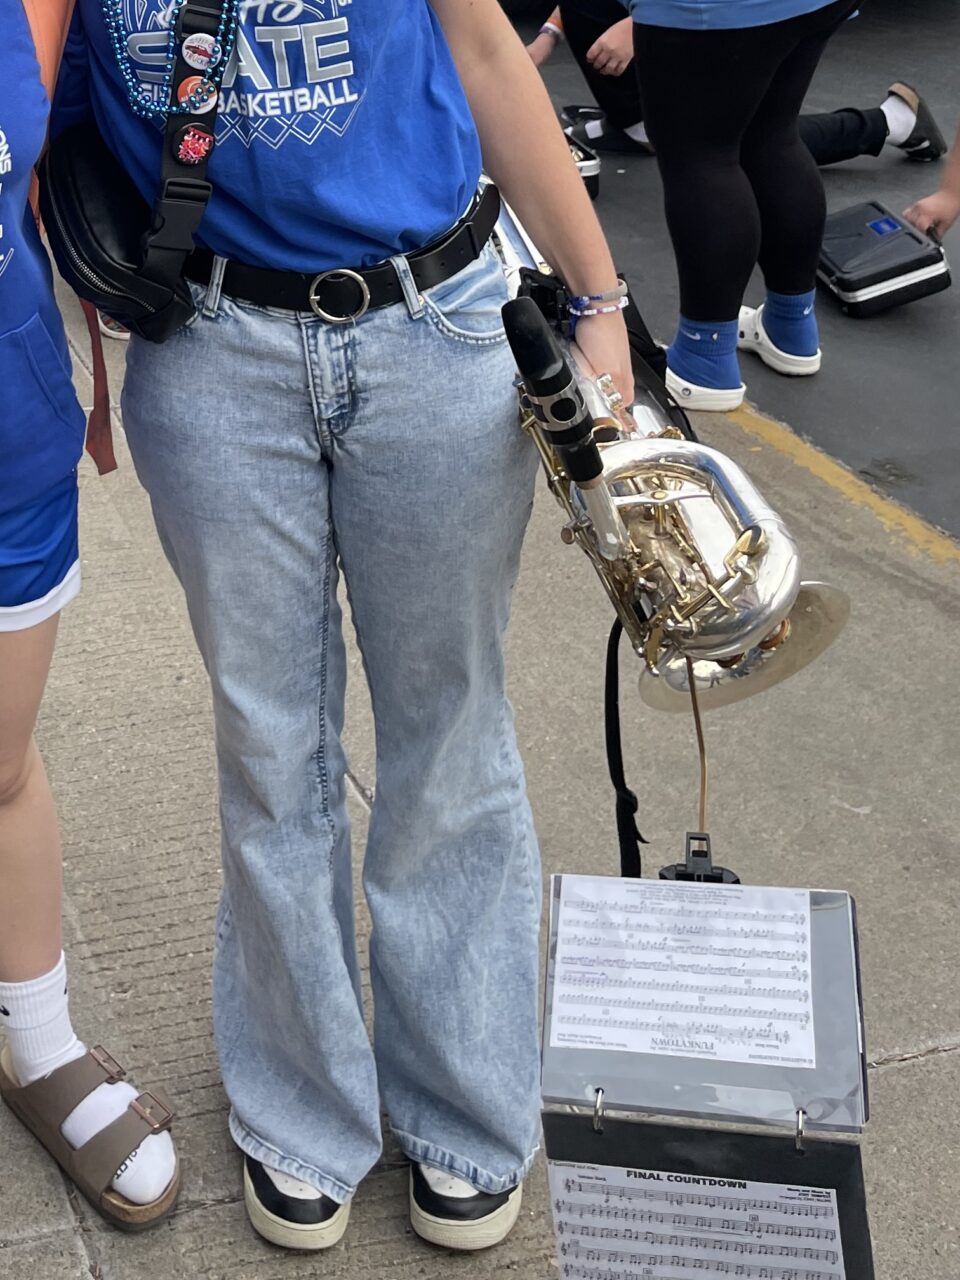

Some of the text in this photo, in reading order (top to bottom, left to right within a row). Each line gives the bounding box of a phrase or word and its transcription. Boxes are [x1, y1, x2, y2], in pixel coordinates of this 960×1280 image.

[217, 79, 358, 117] BASKETBALL
[650, 1038, 715, 1051] FUNKYTOWN
[626, 1170, 748, 1189] FINAL COUNTDOWN
